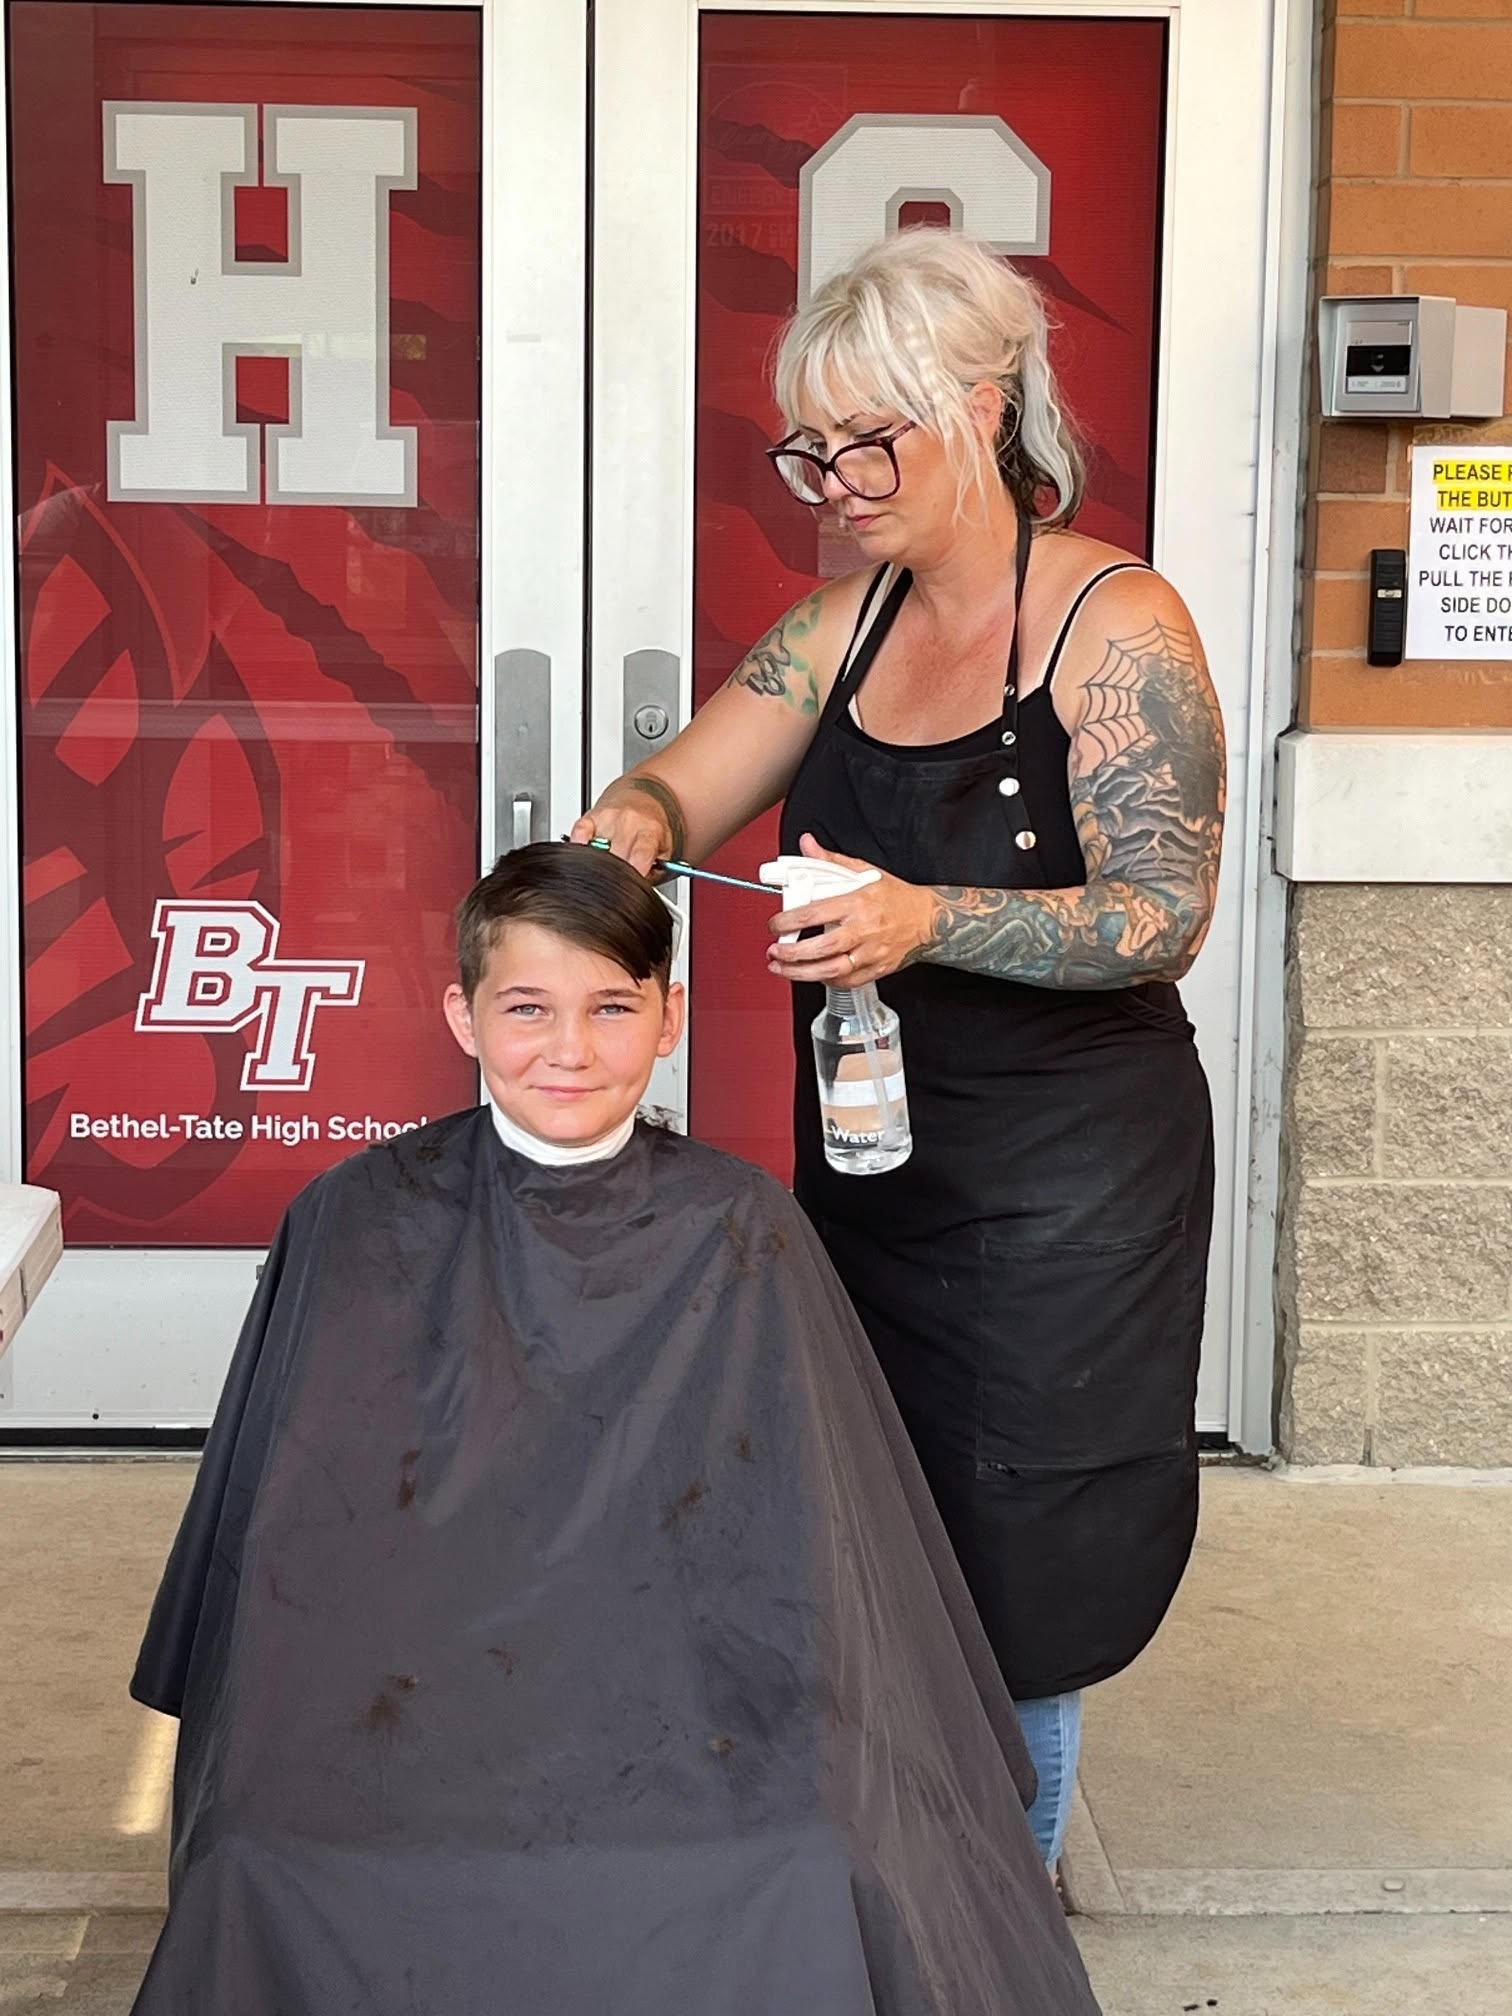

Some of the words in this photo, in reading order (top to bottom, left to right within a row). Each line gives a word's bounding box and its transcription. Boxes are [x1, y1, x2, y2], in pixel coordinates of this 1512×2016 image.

[102, 100, 418, 508] H
[1433, 464, 1502, 481] PLEASE
[1438, 490, 1472, 507] THE
[1478, 491, 1512, 508] BUT
[1430, 517, 1474, 534] WAIT
[1479, 517, 1512, 534] FOR
[1439, 544, 1491, 561] CLICK
[1419, 570, 1463, 587] PULL
[1470, 570, 1503, 587] THE
[1441, 597, 1481, 613] SIDE
[1487, 597, 1511, 614] DO
[1444, 625, 1468, 641] TO
[134, 899, 366, 1091] BT
[70, 1113, 243, 1140] Bethel-Tate
[251, 1114, 320, 1147] High
[831, 1125, 885, 1144] Water
